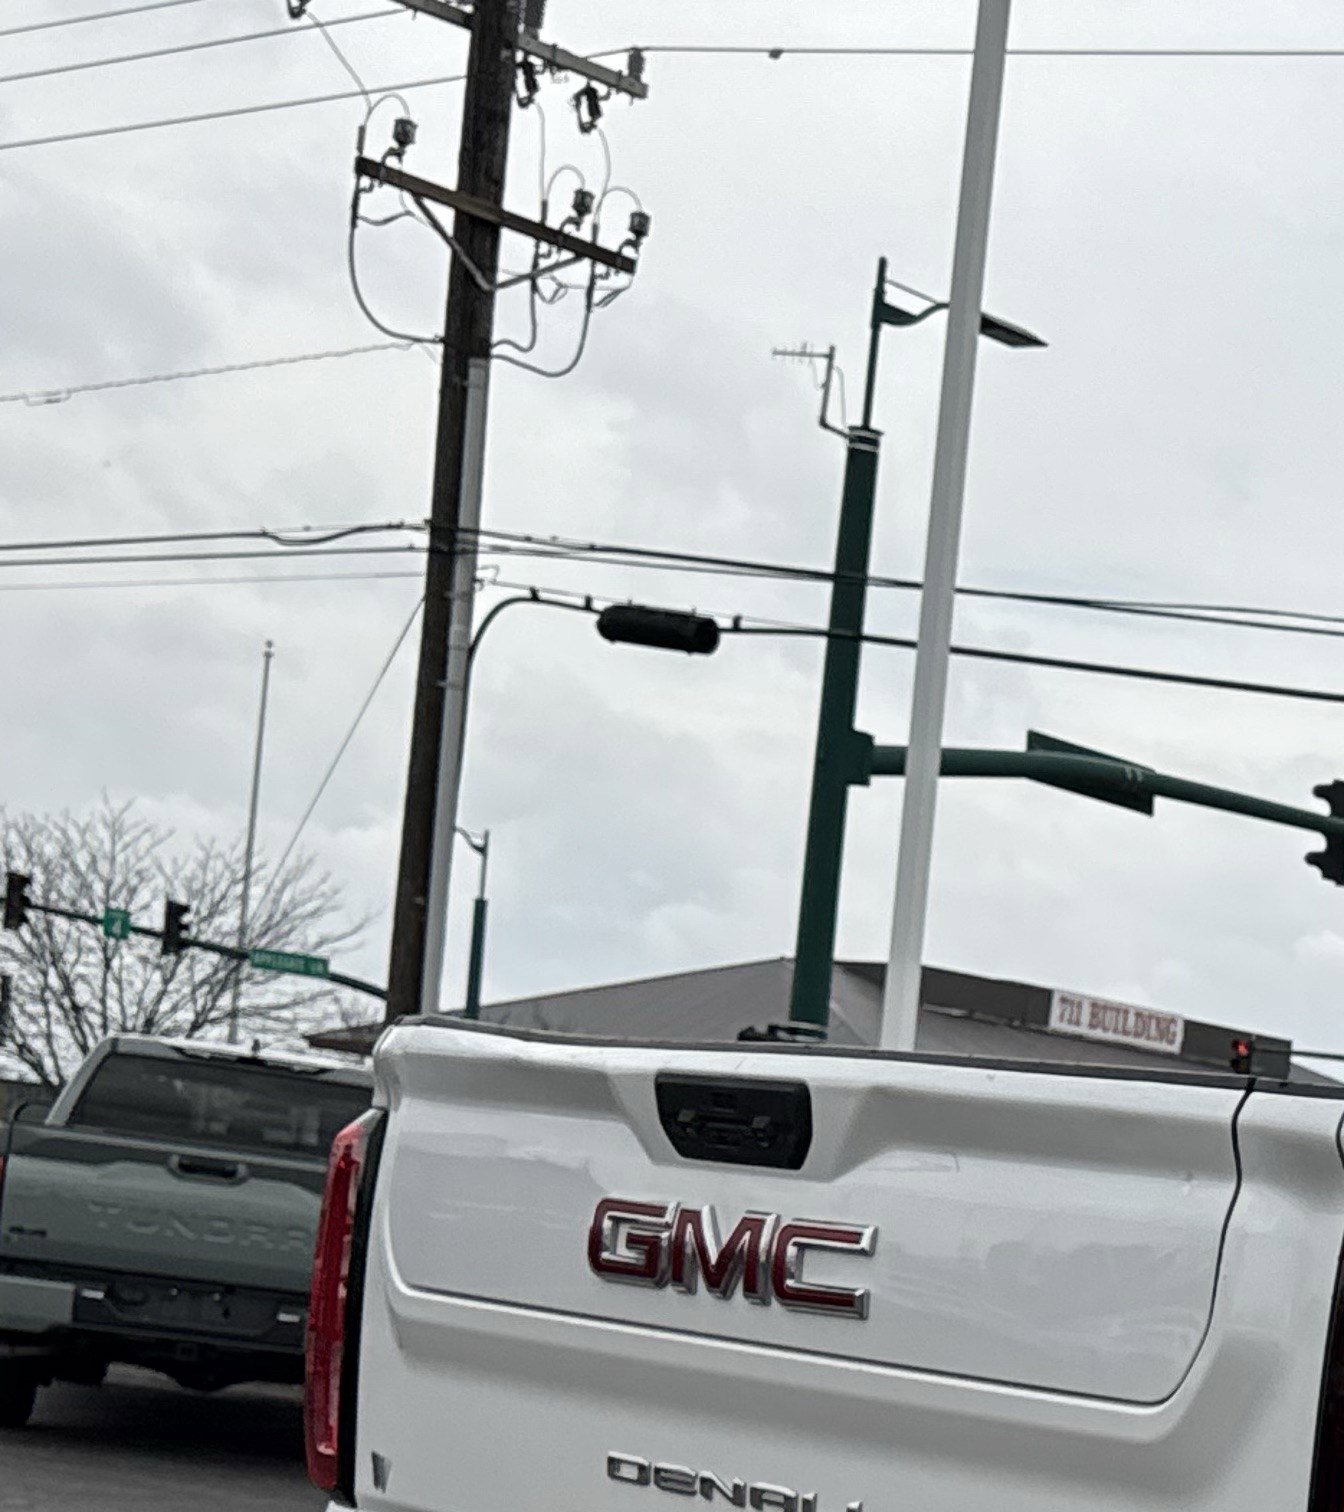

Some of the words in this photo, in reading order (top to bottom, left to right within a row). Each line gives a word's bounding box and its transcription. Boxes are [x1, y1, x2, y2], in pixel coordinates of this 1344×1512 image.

[1059, 995, 1081, 1026] 711
[1088, 1001, 1178, 1046] BUILDING
[87, 1200, 314, 1252] TUNDRA
[588, 1197, 879, 1321] GMC
